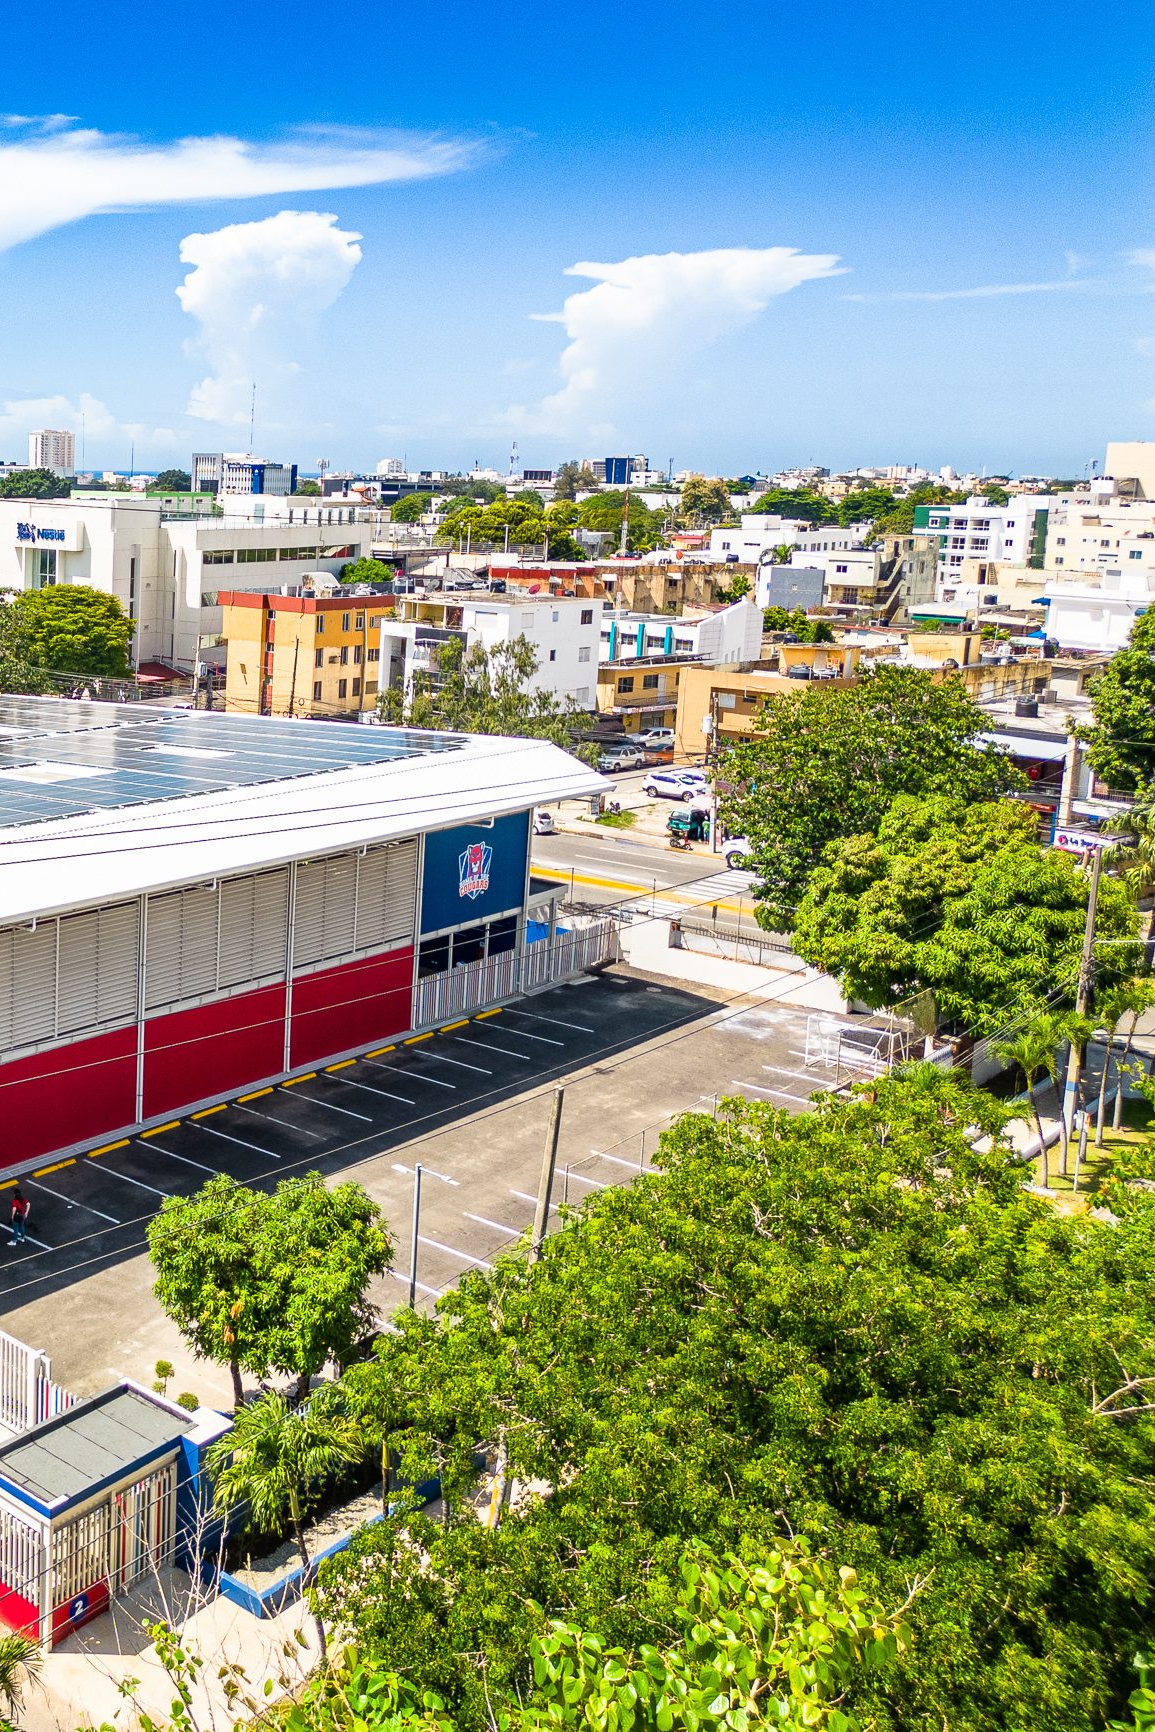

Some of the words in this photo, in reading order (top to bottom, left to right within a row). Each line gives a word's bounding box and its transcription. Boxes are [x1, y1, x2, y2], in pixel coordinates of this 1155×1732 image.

[37, 528, 65, 541] Nestlé
[459, 879, 489, 897] COUGARS
[75, 1600, 84, 1616] 2
